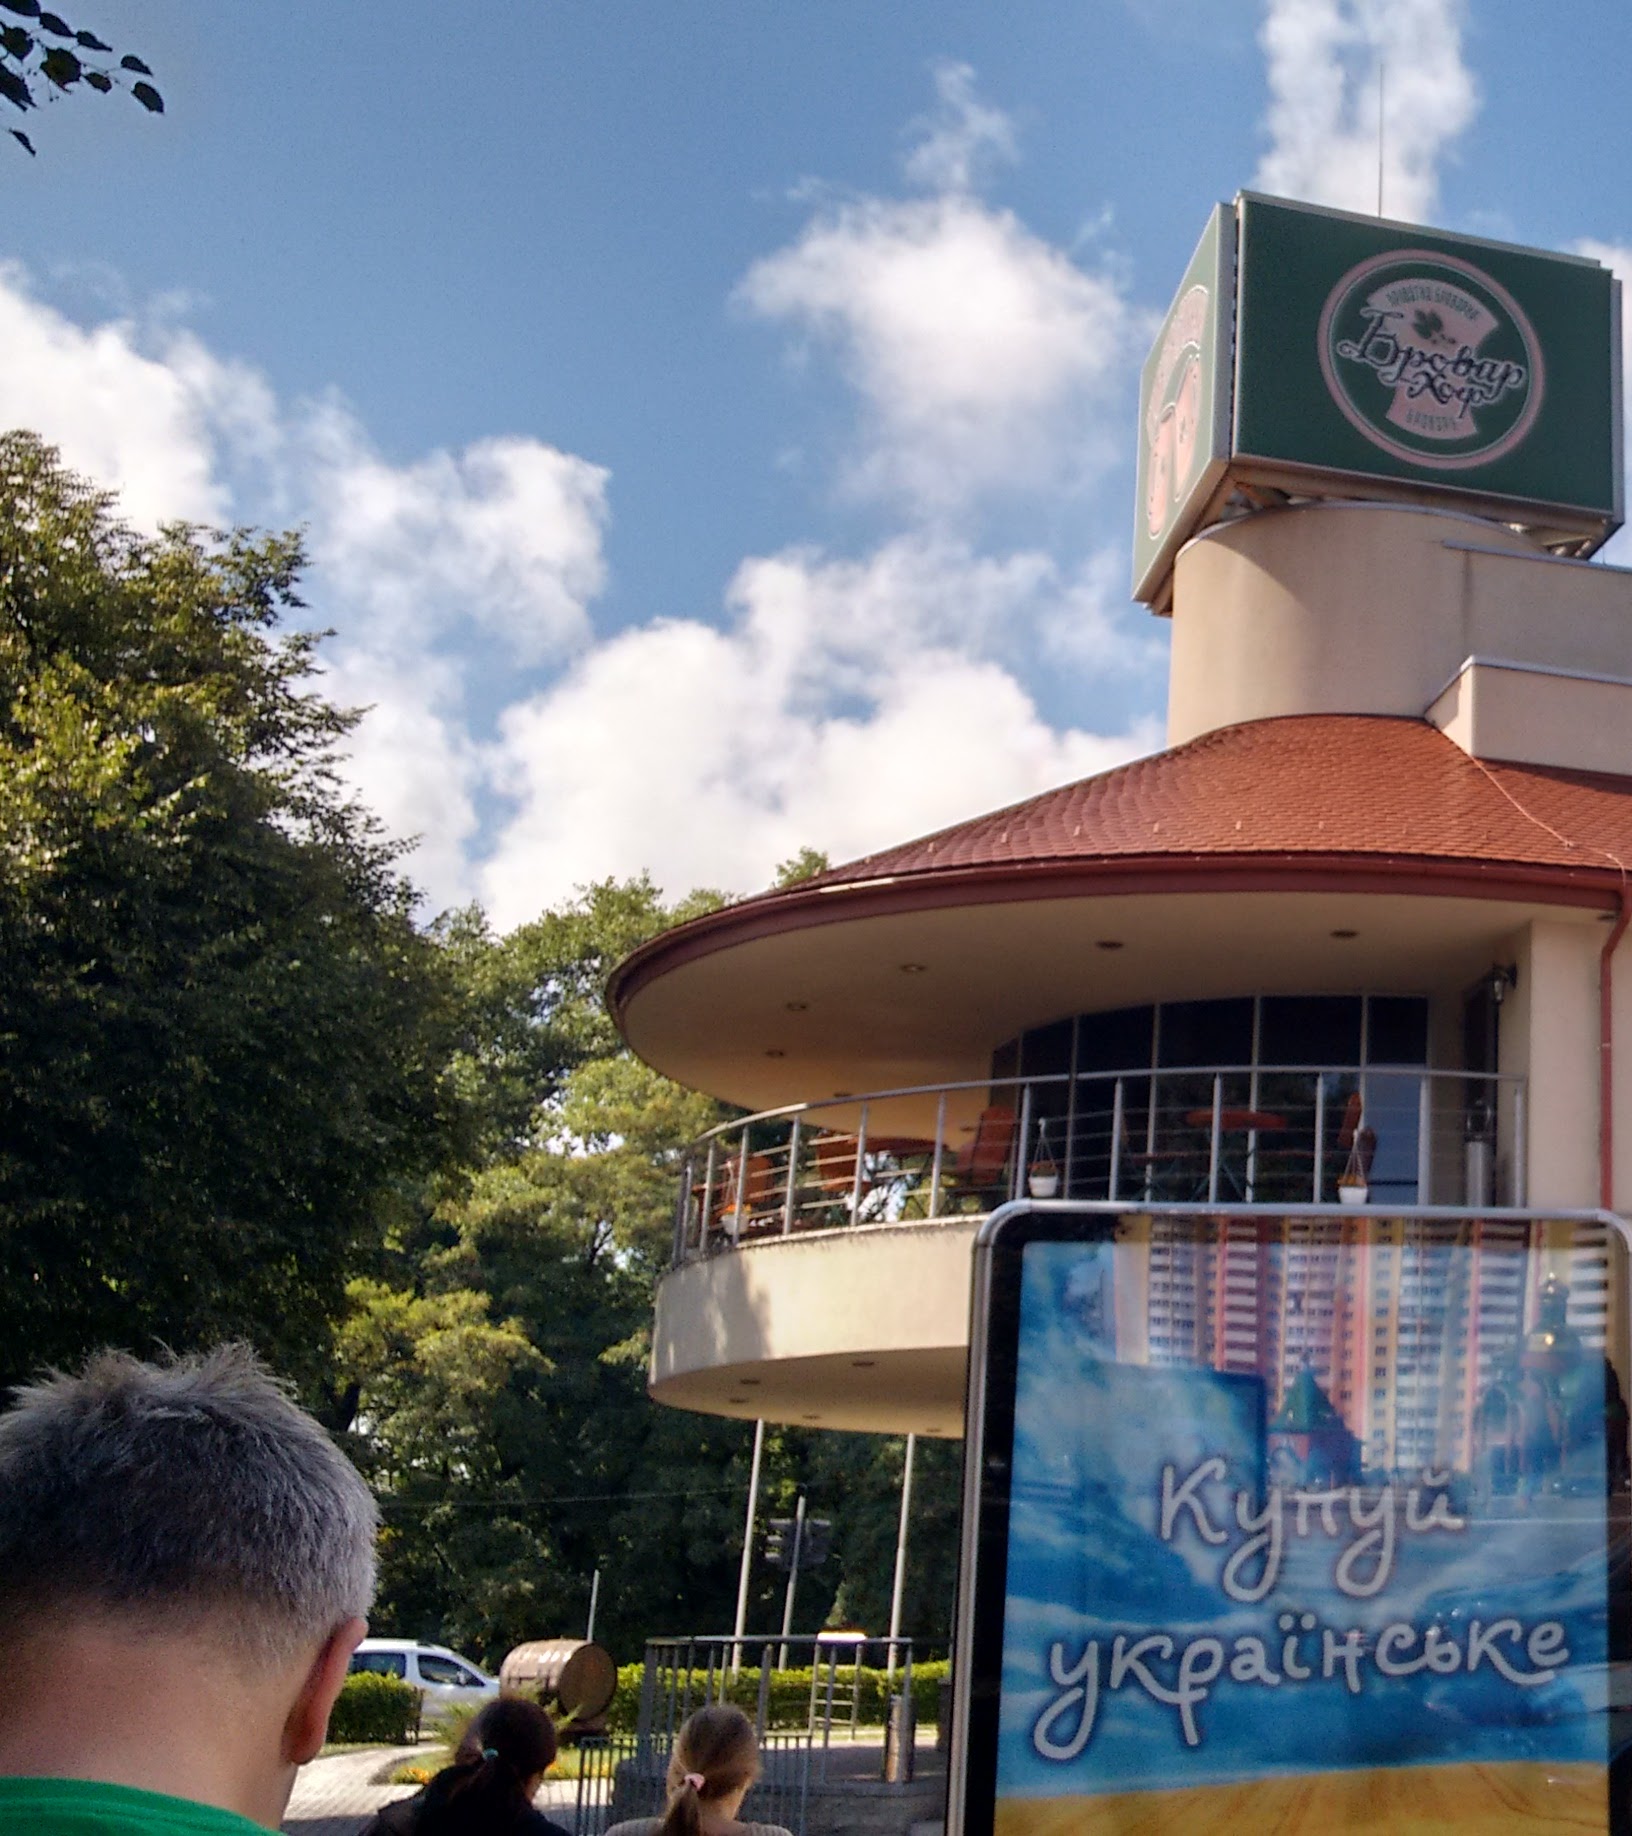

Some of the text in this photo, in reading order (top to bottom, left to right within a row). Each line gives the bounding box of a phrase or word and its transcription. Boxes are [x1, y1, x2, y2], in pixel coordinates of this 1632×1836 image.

[1338, 307, 1525, 401] Бровар
[1401, 371, 1484, 418] Хоф
[1159, 1457, 1464, 1603] Купуй
[1033, 1614, 1569, 1760] українське
